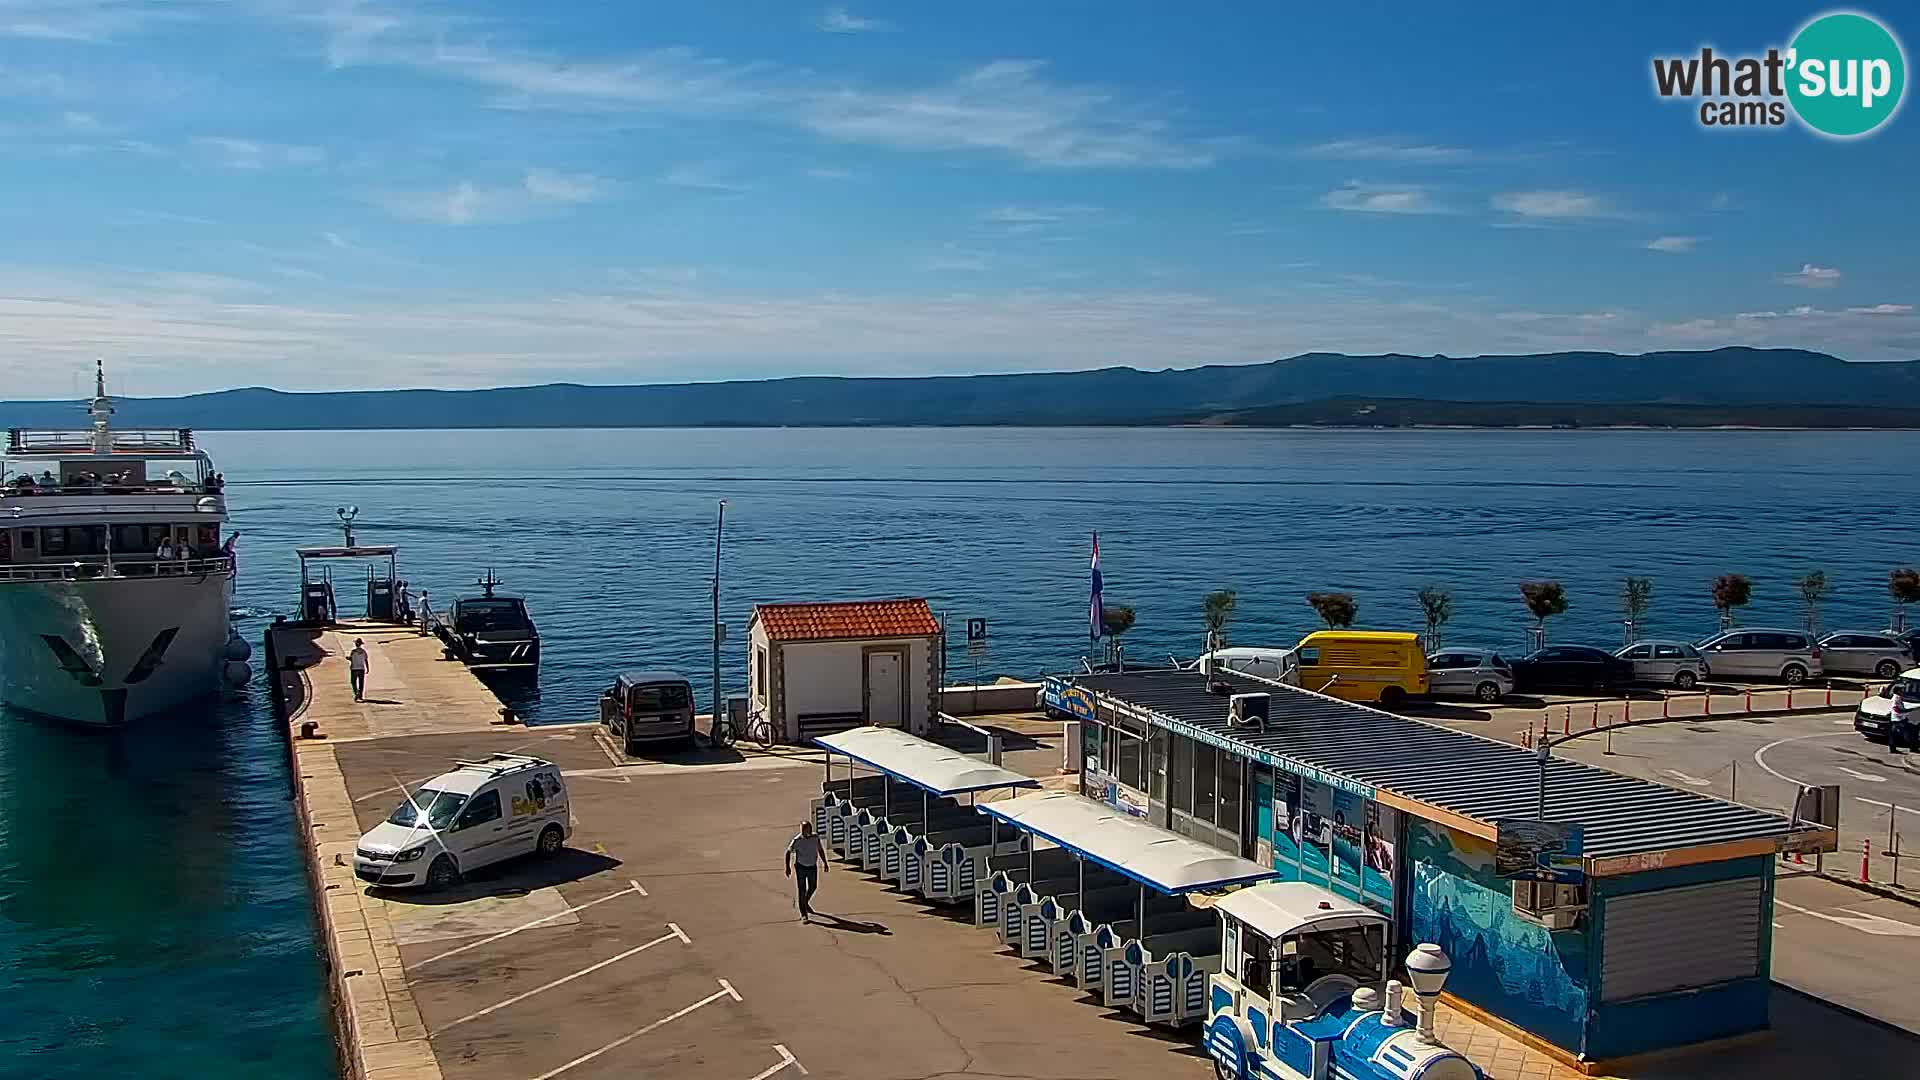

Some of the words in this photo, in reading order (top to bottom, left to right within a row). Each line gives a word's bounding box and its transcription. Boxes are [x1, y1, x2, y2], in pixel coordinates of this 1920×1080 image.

[1231, 742, 1260, 760] POSTAJA
[1270, 756, 1284, 768] BUS
[1285, 761, 1316, 778] STATION
[1318, 772, 1343, 787] TICKET
[1344, 780, 1371, 796] OFFICE
